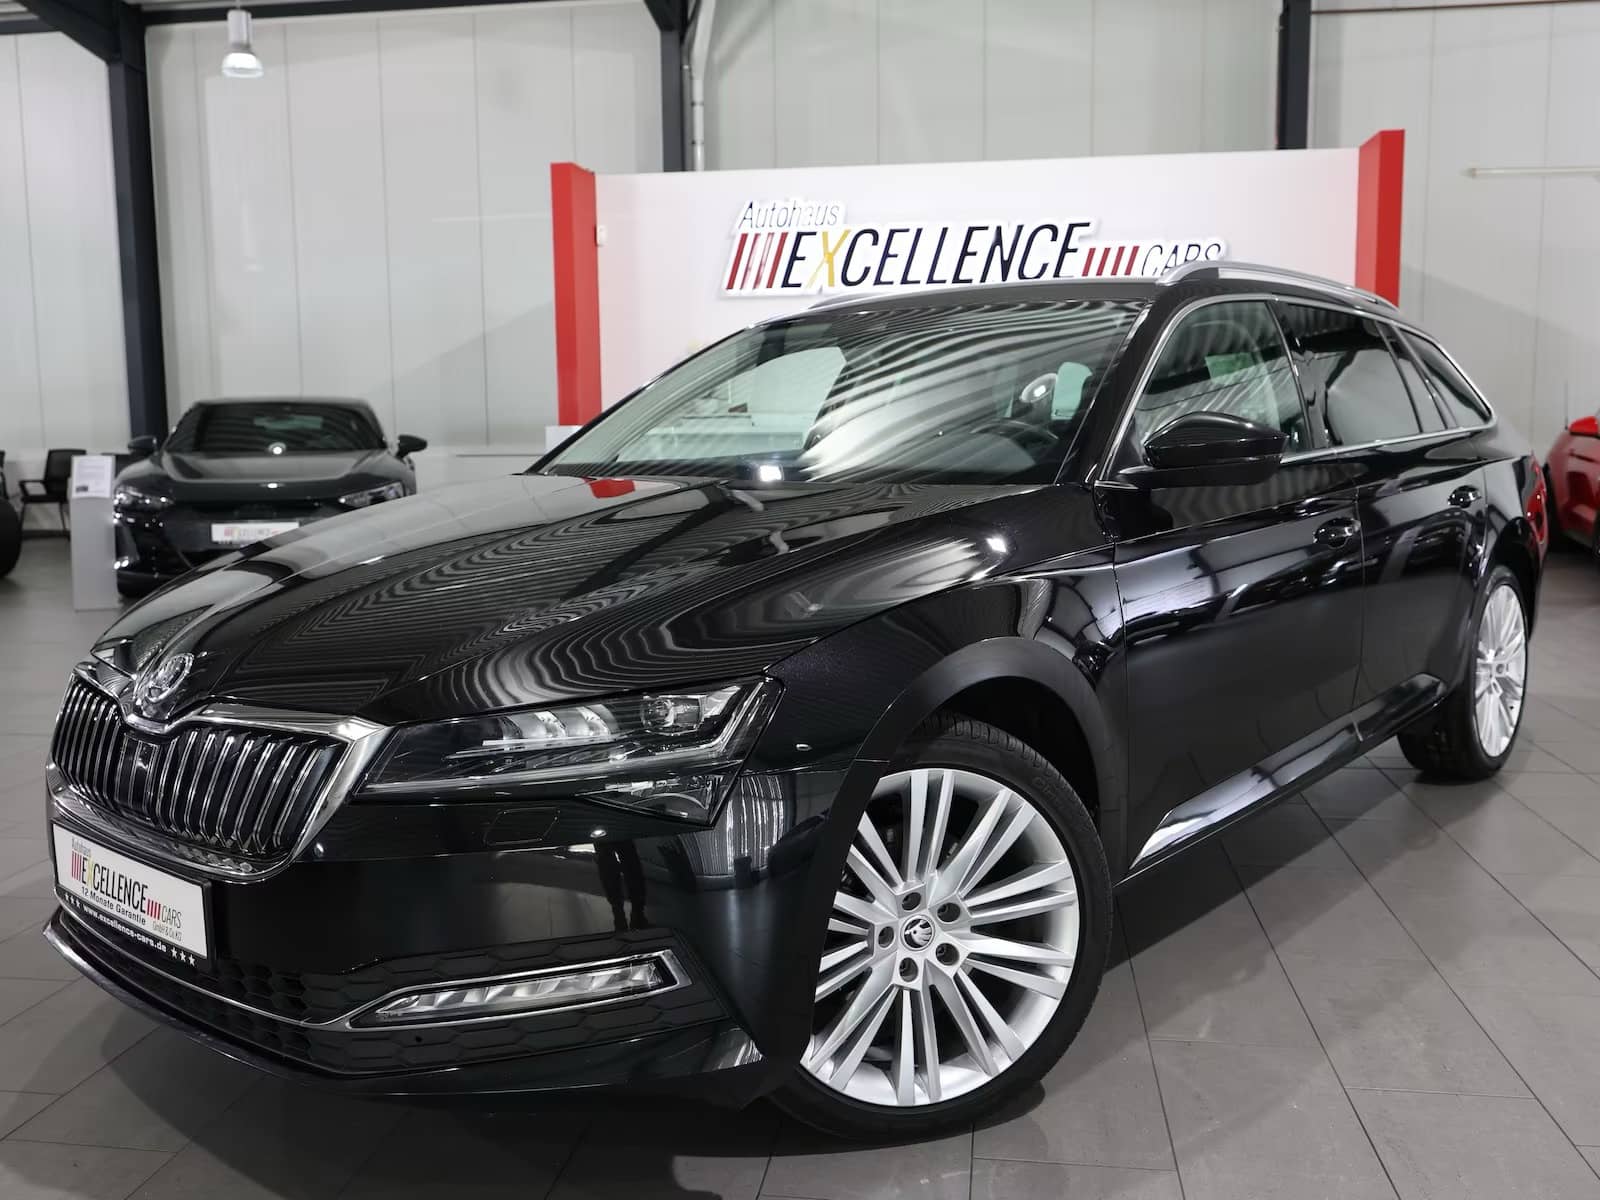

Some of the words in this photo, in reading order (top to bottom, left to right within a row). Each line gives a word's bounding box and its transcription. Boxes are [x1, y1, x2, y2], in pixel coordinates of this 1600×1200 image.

[738, 200, 840, 229] Autohaus
[781, 222, 1091, 288] EXCELLENCE
[82, 856, 148, 914] EXCELLENCE
[162, 905, 182, 929] CARS
[82, 886, 89, 896] 12
[90, 891, 114, 910] Monate
[115, 903, 146, 926] Garantie
[83, 903, 167, 953] www.excellence-cars.de
